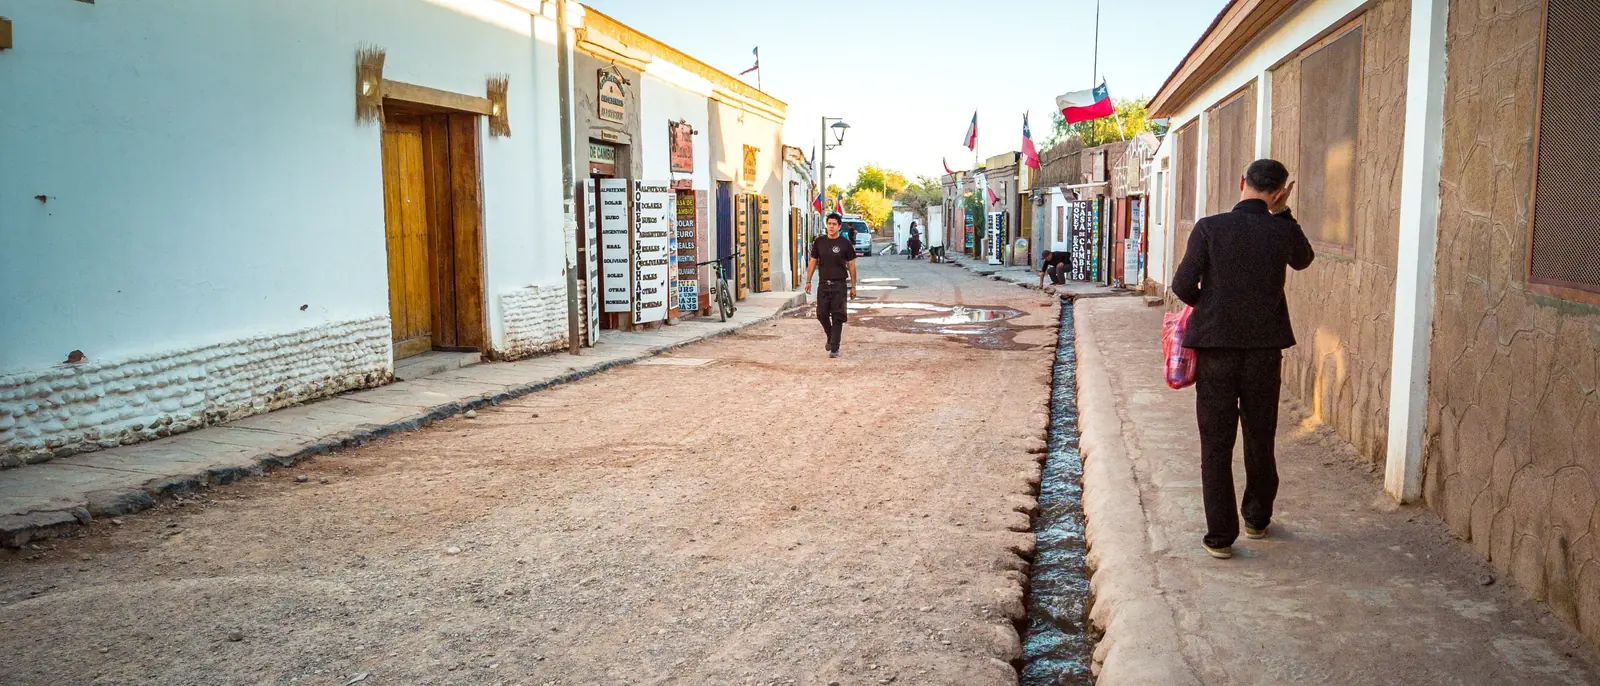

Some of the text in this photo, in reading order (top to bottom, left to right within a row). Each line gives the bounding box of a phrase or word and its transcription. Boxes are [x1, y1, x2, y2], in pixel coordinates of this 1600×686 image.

[590, 145, 614, 160] DE CAMBIO
[642, 300, 662, 309] MONEDAS
